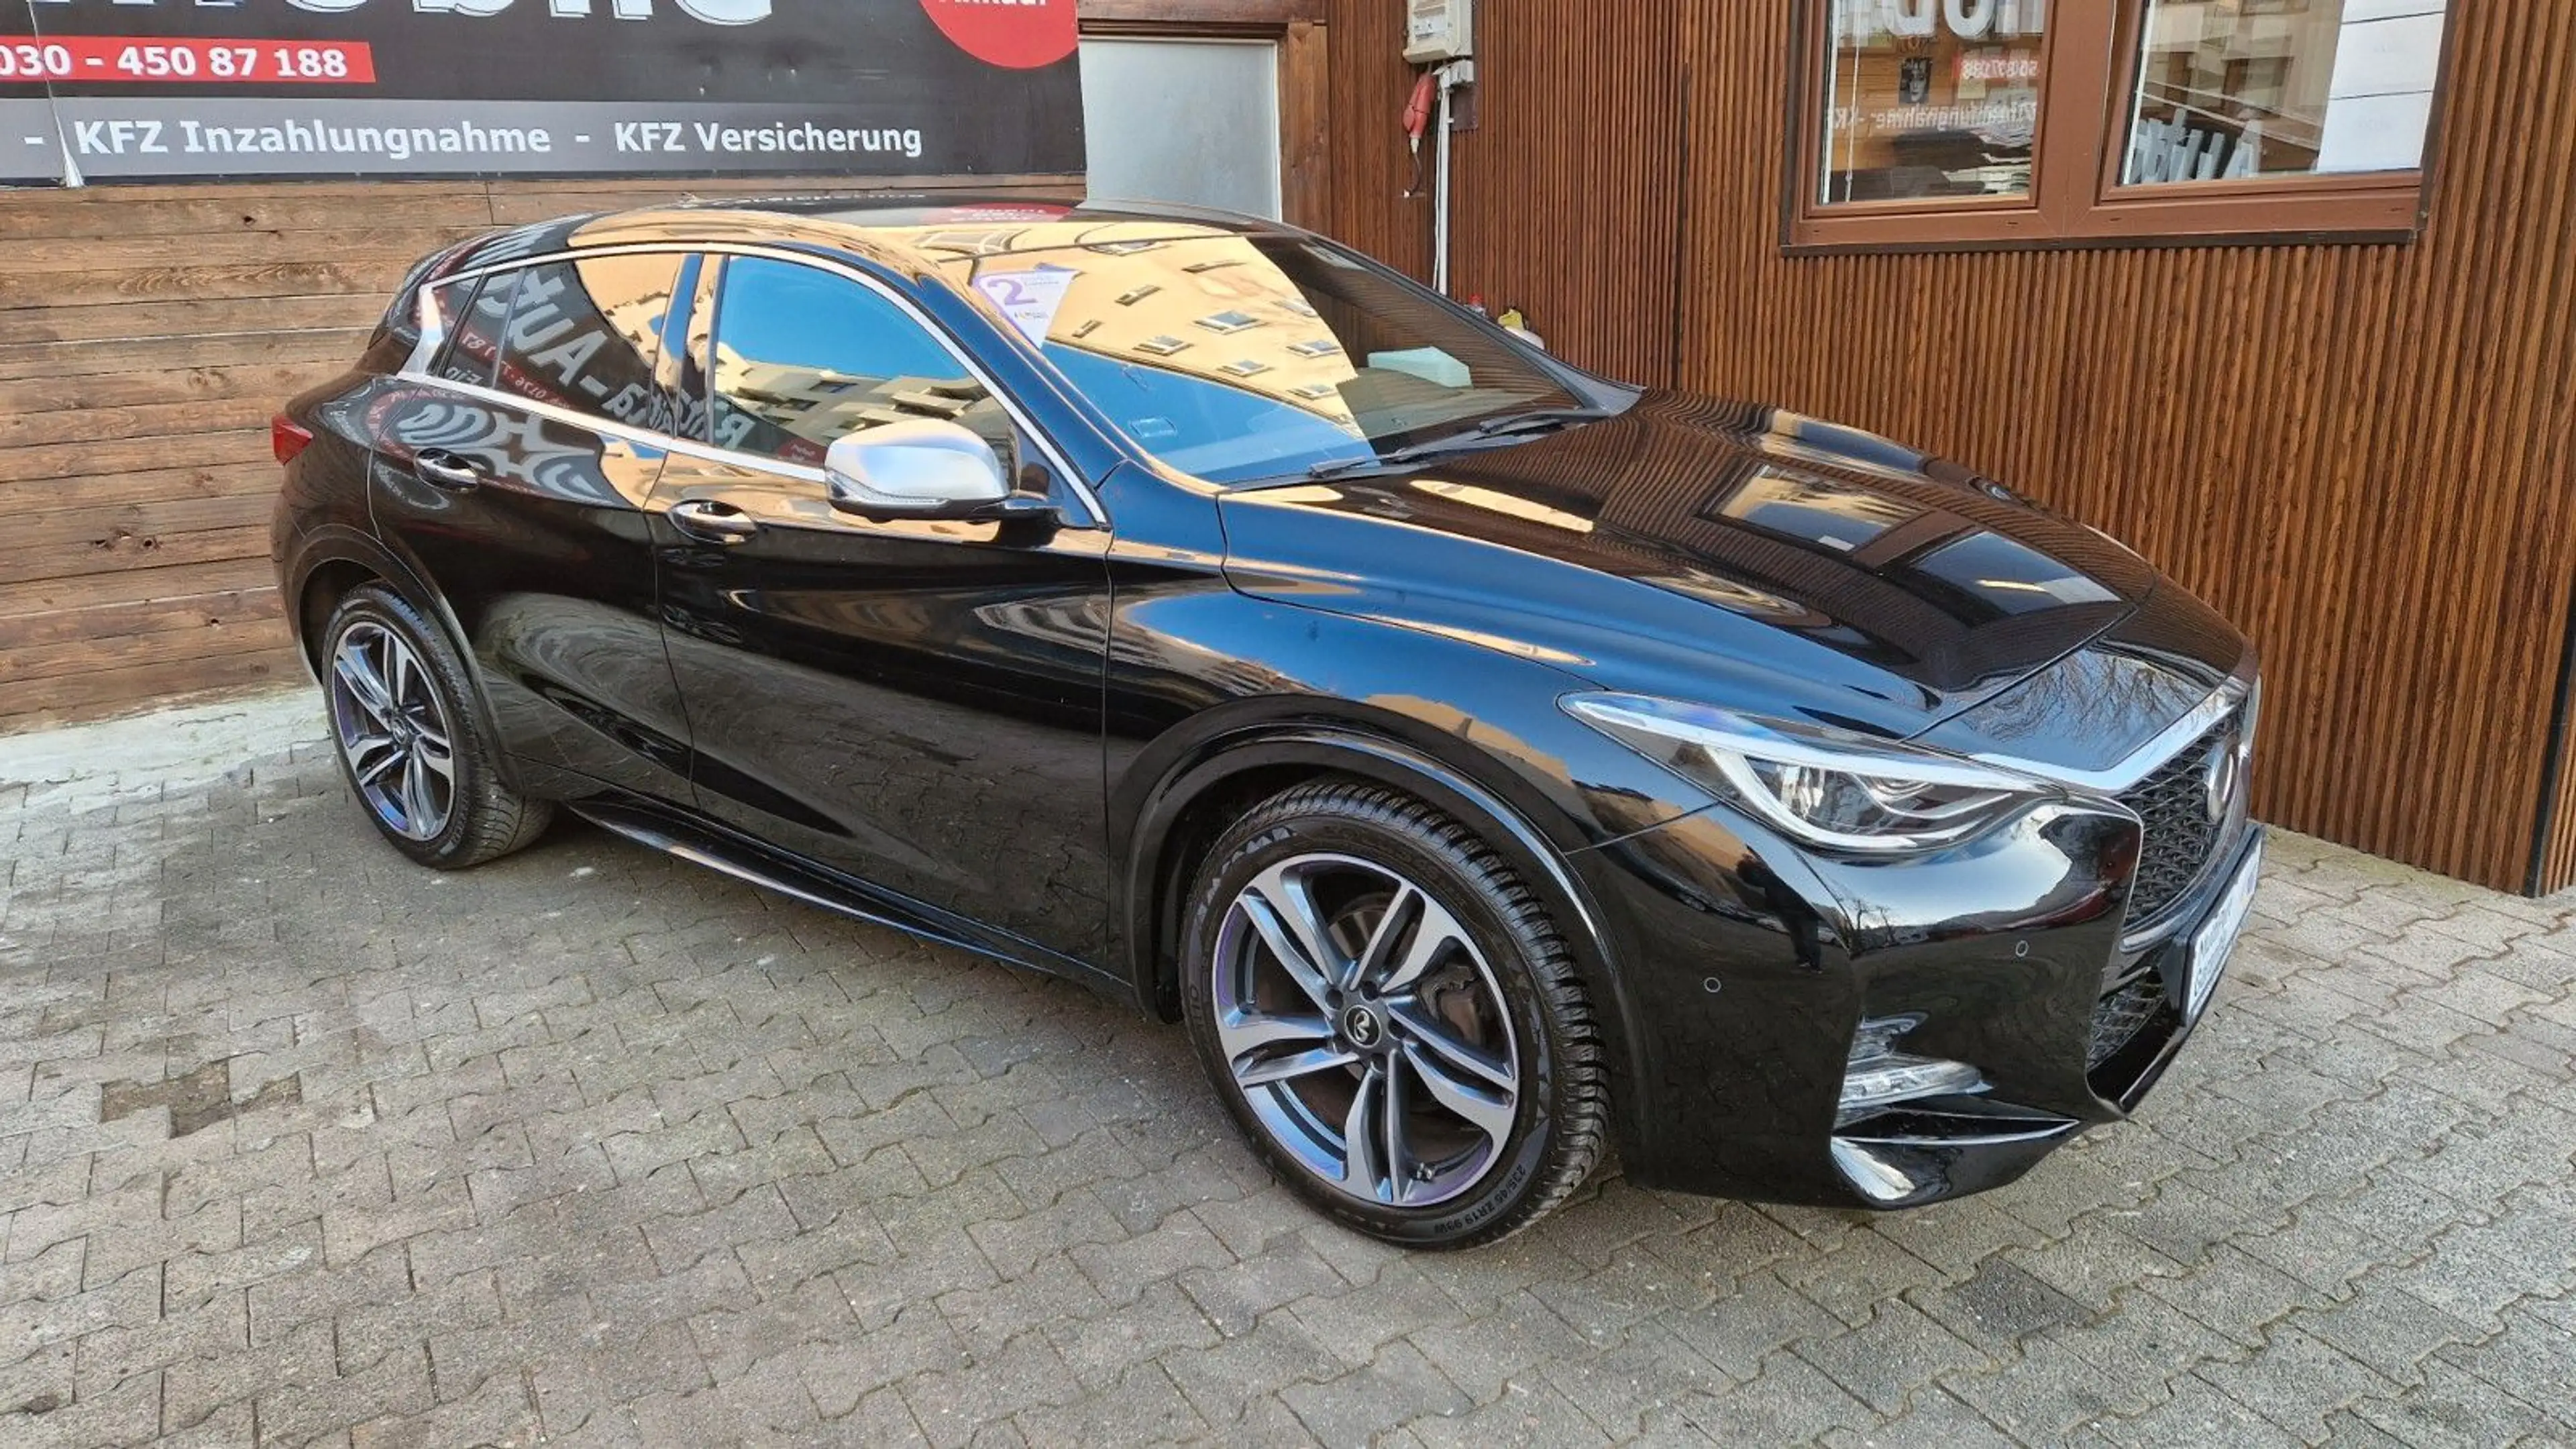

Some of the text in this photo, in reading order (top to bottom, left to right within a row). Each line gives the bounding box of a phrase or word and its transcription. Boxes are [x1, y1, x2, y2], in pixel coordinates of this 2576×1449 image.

[117, 46, 197, 76] 450
[209, 48, 258, 76] 87
[274, 48, 348, 77] 188
[73, 120, 169, 155] KFZ
[180, 119, 551, 160] Inzahlungnahme
[614, 121, 686, 153] KFZ
[693, 121, 922, 158] Versicherung
[987, 278, 1038, 307] 2
